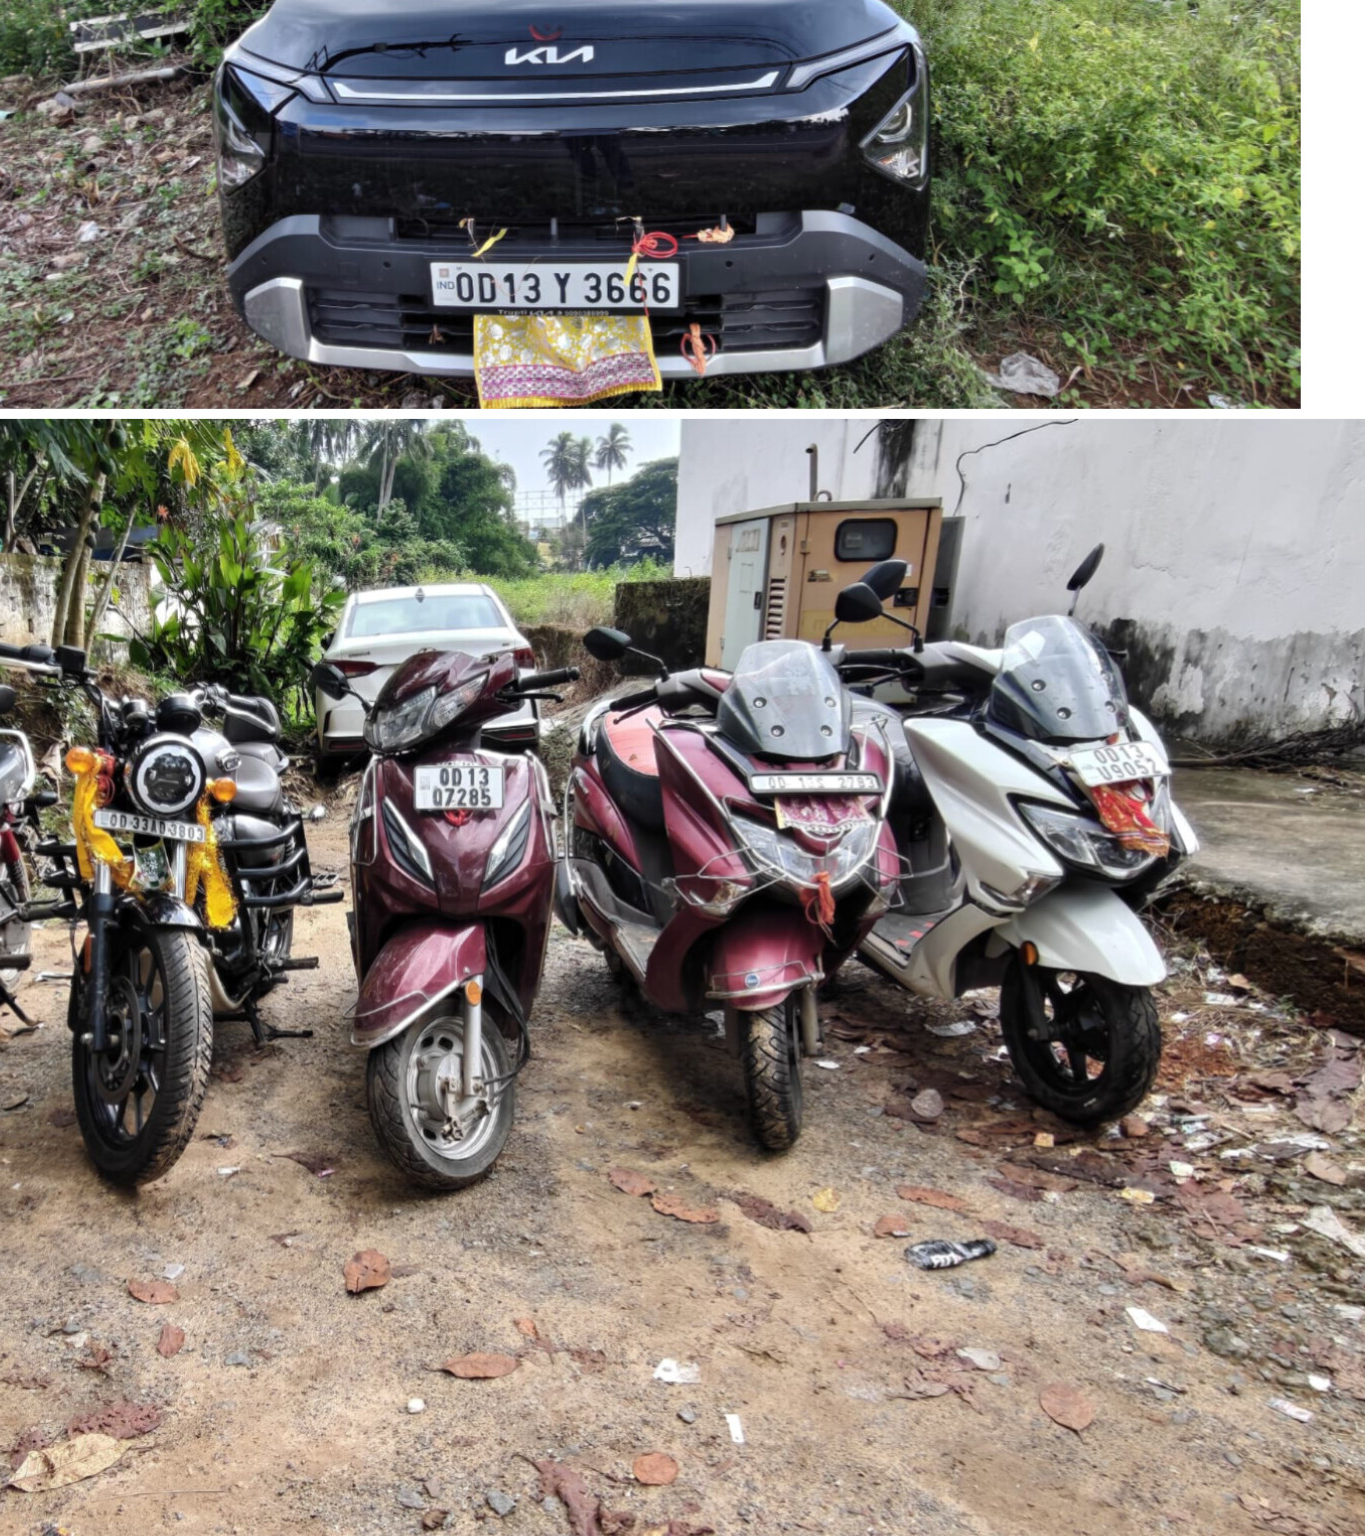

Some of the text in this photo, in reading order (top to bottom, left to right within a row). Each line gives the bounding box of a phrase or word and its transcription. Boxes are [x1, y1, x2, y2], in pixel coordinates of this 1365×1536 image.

[504, 45, 594, 65] KIA
[436, 280, 455, 290] IND
[456, 272, 671, 304] OD13 Y 3666
[439, 767, 489, 787] OD 13
[110, 813, 127, 828] OD
